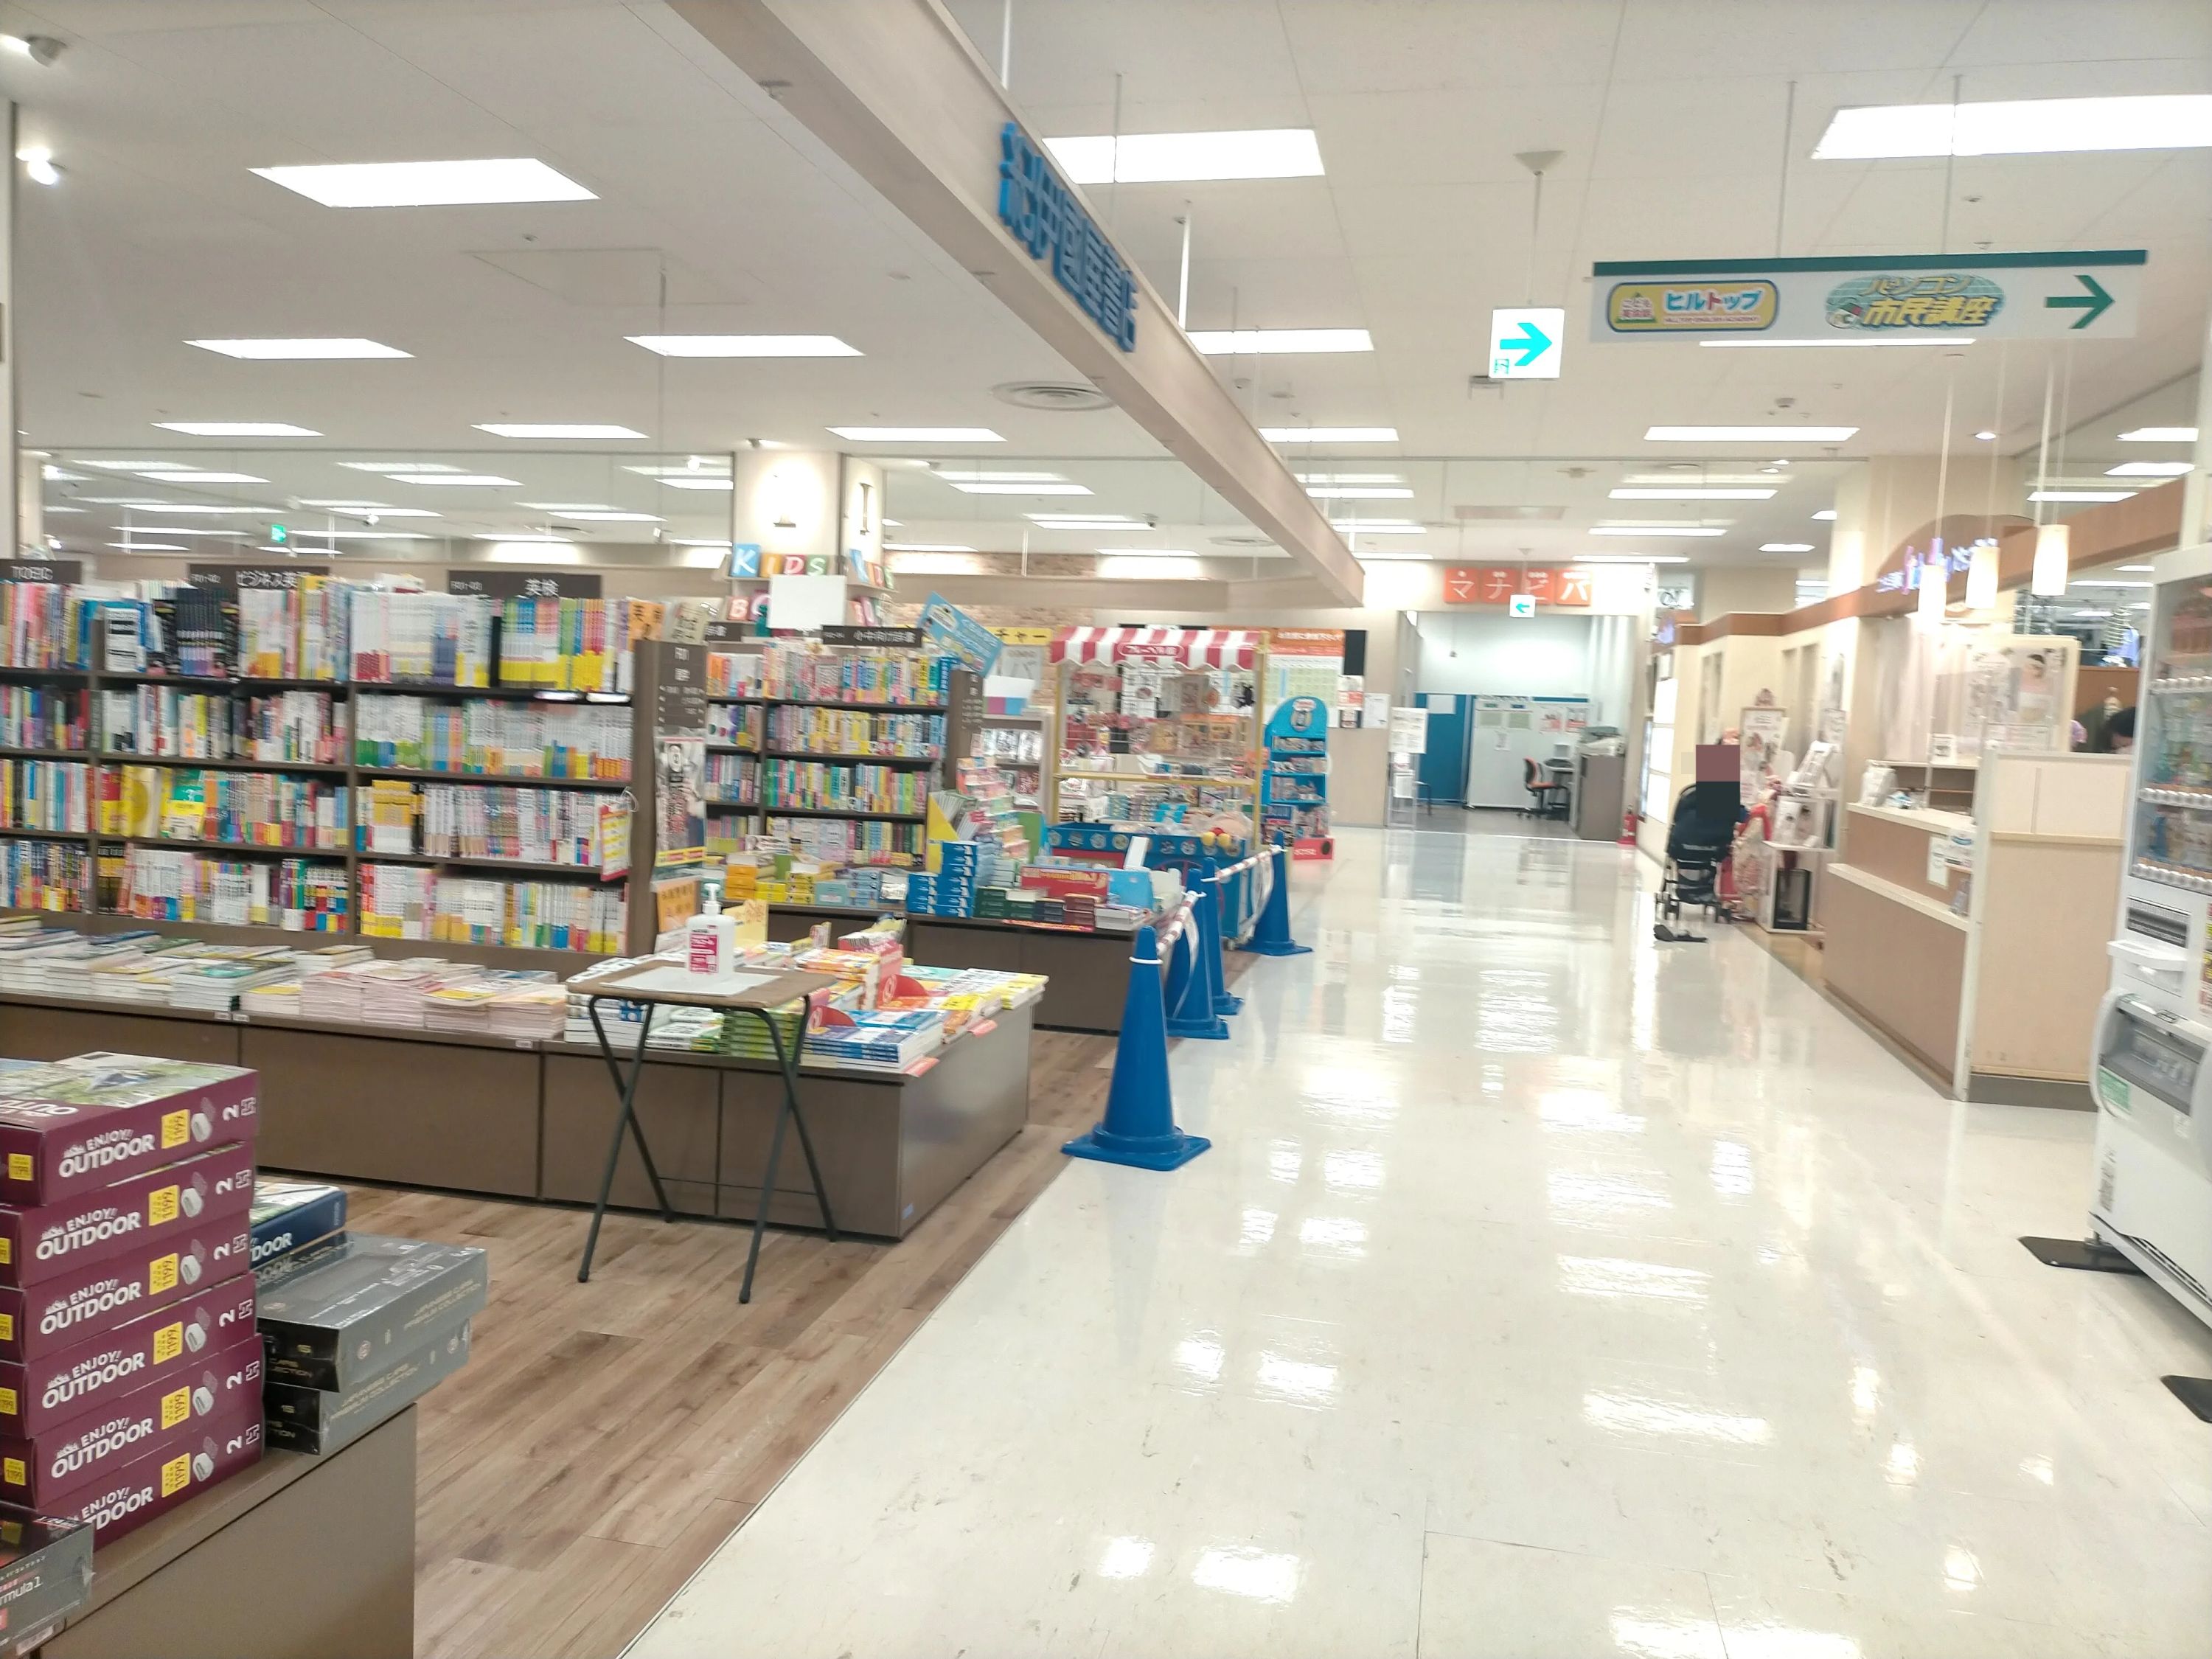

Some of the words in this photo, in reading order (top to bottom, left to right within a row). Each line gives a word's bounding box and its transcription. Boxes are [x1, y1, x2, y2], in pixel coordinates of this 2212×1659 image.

[1666, 290, 1762, 310] ヒルトップ
[1863, 296, 1998, 327] 市民講座
[731, 548, 827, 576] KIDS
[58, 1134, 156, 1178] OUTDOOR
[66, 1207, 118, 1232] ENJOY!
[36, 1211, 142, 1260] OUTDOOR
[69, 1279, 119, 1304] ENJOY!
[40, 1281, 142, 1334] OUTDOOR
[72, 1350, 122, 1379] ENJOY!
[42, 1352, 145, 1409] OUTDOOR
[80, 1417, 131, 1447] ENJOY!
[51, 1418, 153, 1478] OUTDOOR
[82, 1486, 131, 1517] ENJOY!
